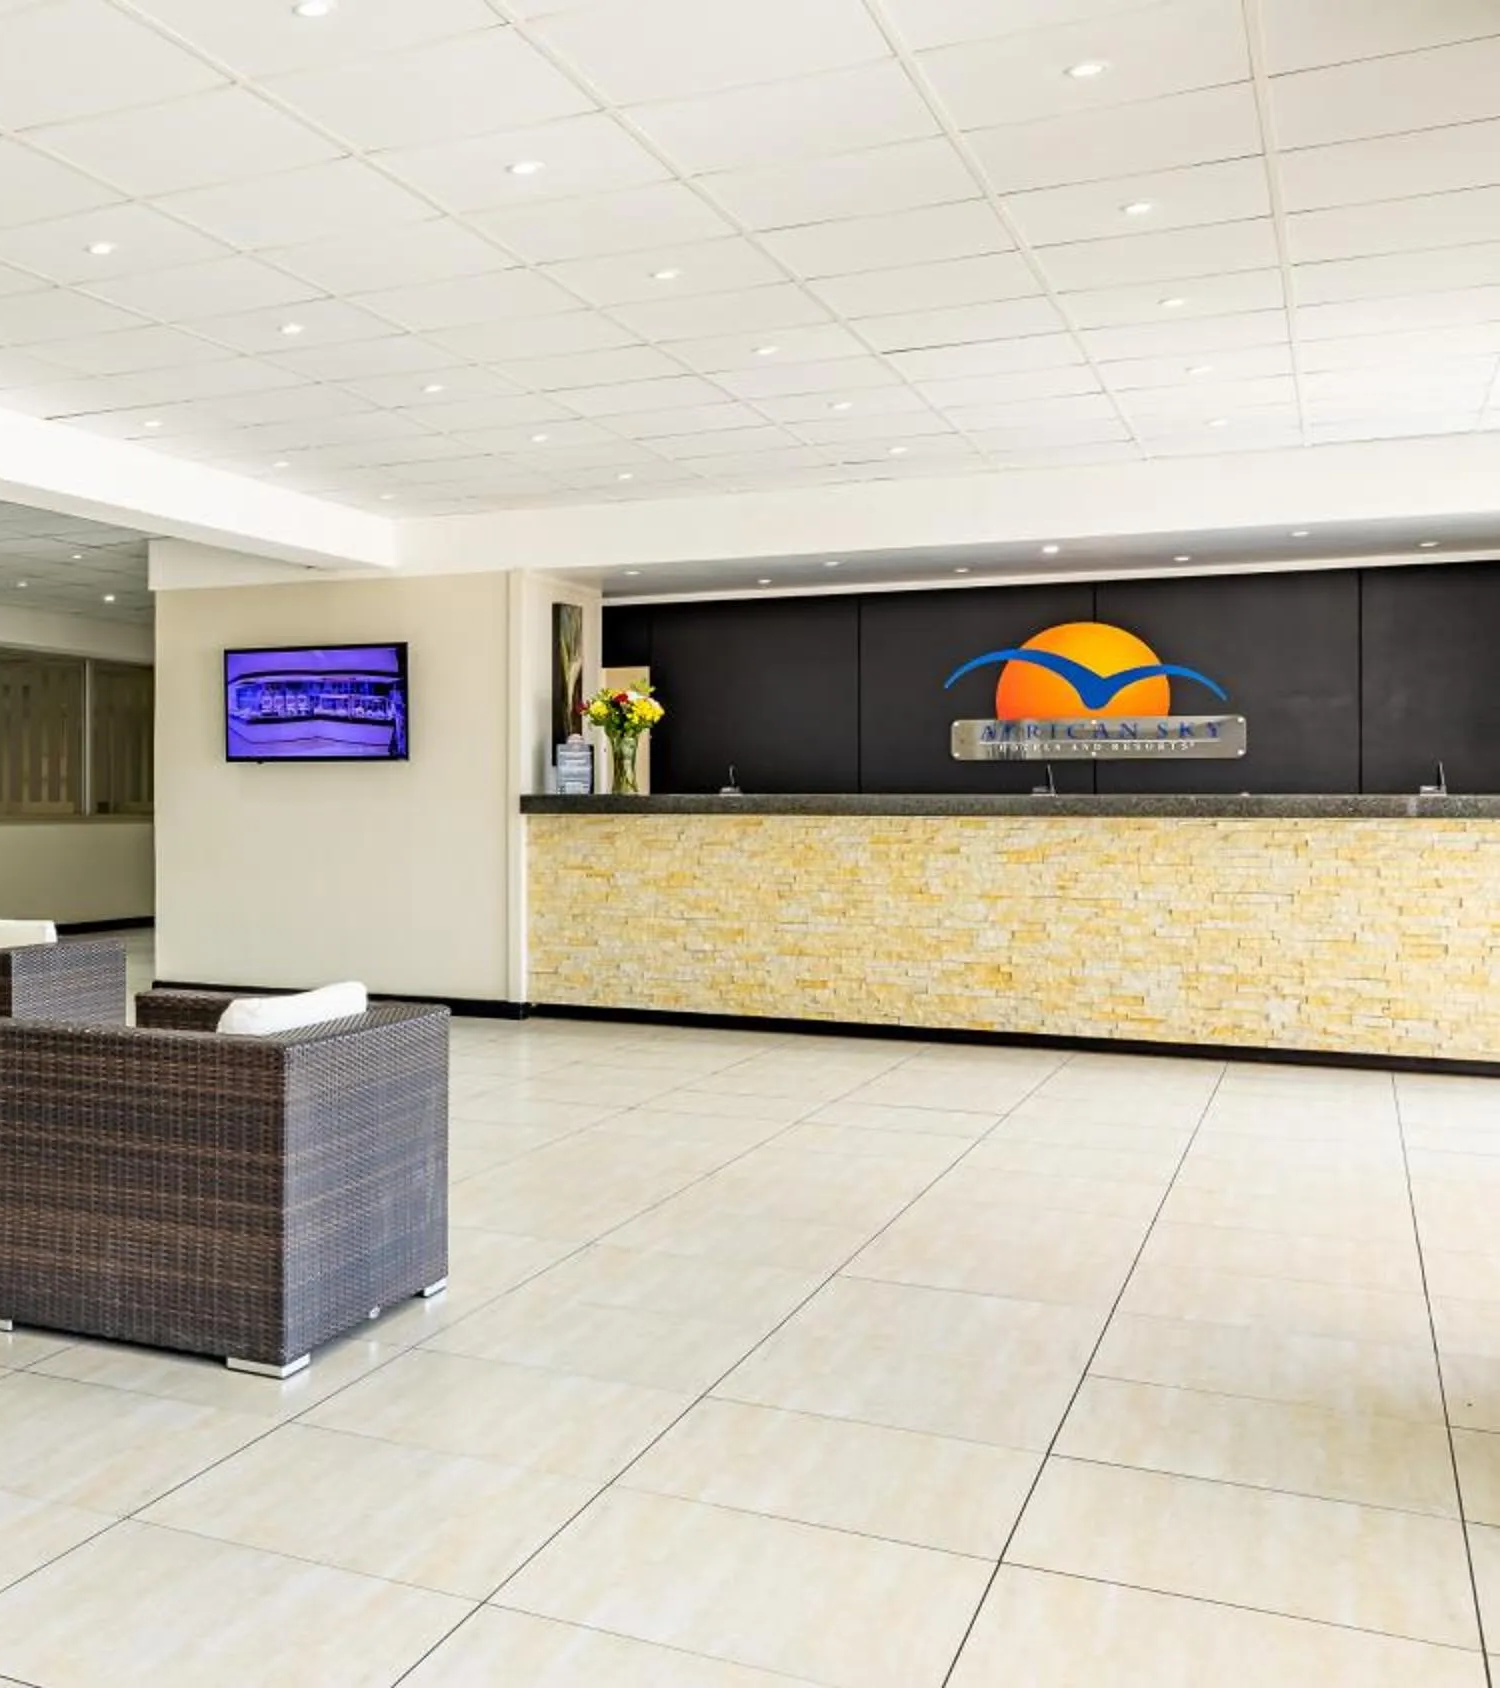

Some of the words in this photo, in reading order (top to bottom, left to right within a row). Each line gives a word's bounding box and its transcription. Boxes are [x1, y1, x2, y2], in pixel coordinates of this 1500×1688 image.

[981, 722, 1139, 740] AFRICAN
[1155, 721, 1224, 739] SKY
[1072, 743, 1102, 751] AND
